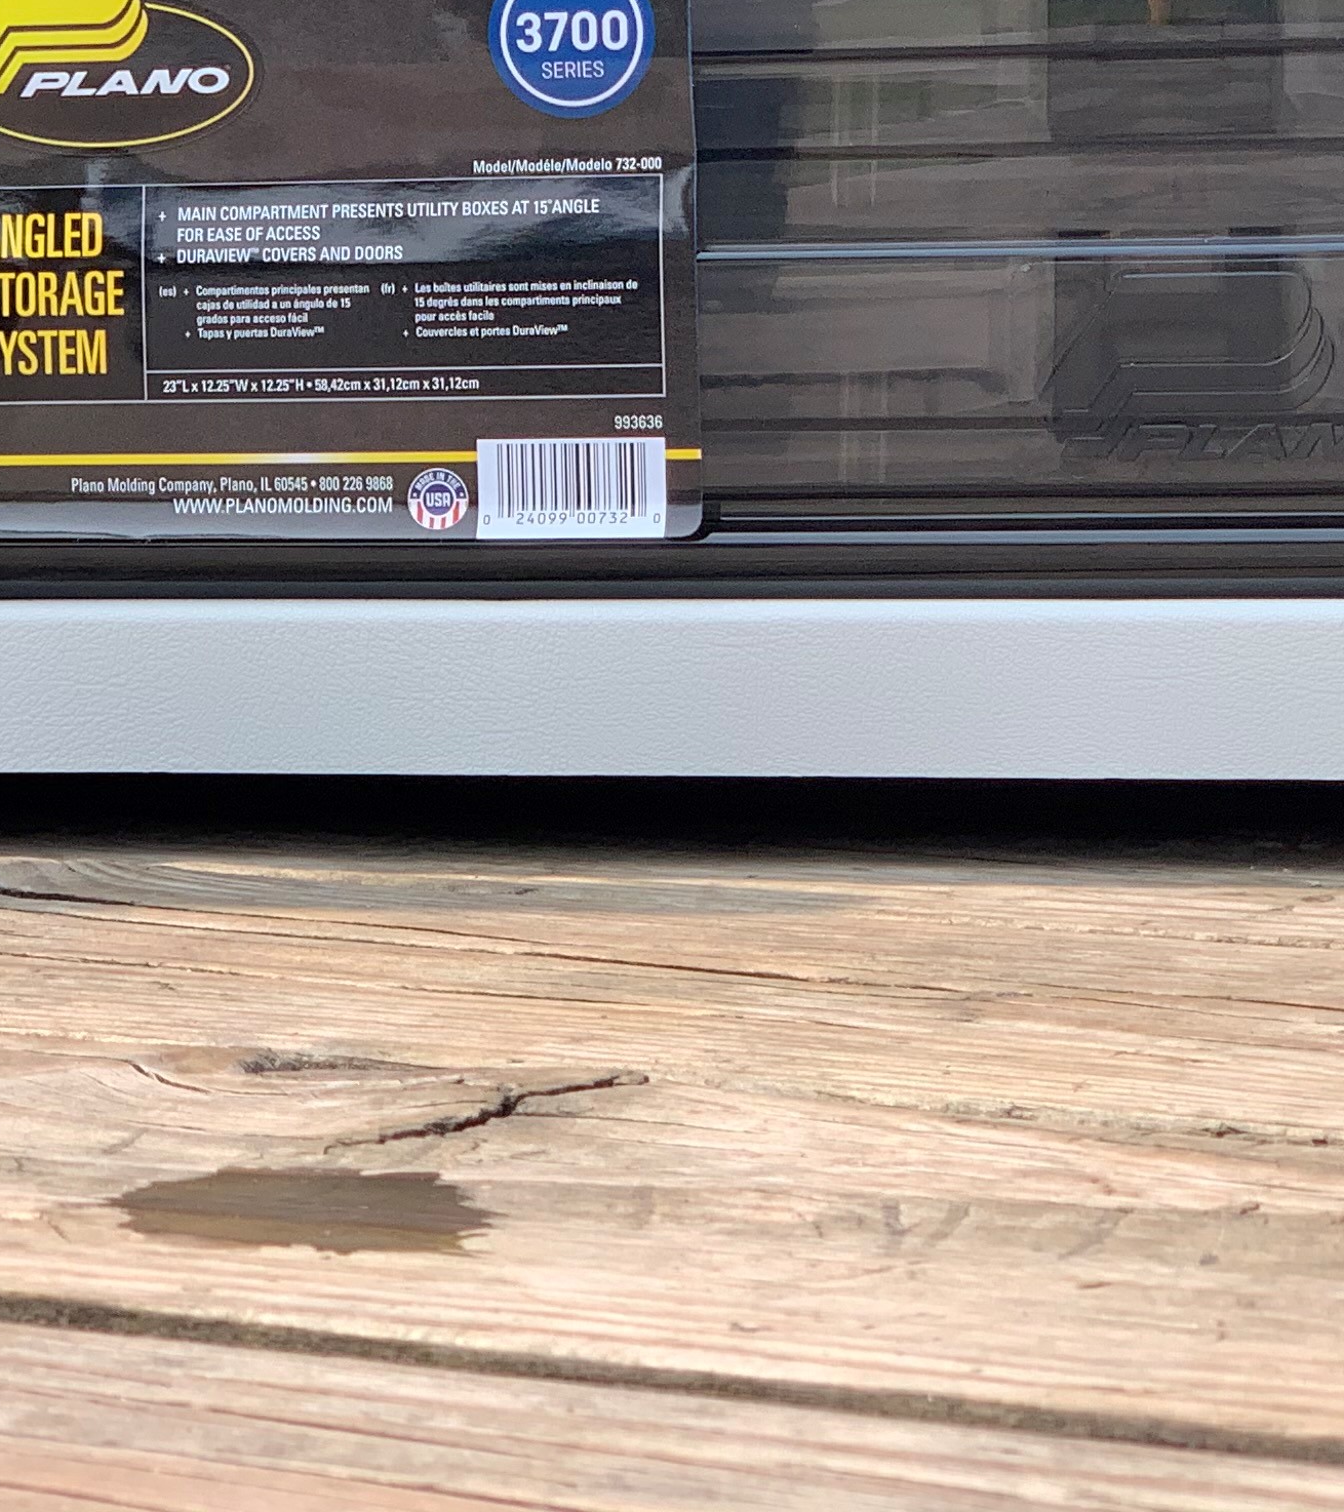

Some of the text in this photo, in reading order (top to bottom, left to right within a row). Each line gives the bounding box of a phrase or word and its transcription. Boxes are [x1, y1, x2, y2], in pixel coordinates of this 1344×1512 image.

[516, 9, 629, 53] 3700
[541, 60, 605, 80] SERIES
[20, 66, 230, 98] PLANO
[615, 156, 662, 171] 732-000
[177, 207, 217, 221] MAIN
[220, 204, 329, 221] COMPARTMENT
[331, 202, 404, 219] PRESENTS
[407, 202, 458, 217] UTILITY
[462, 200, 508, 216] BOXES
[512, 199, 530, 214] AT
[177, 225, 321, 242] FOR EASE OF ACCESS
[262, 247, 317, 263] COVERS
[319, 245, 351, 261] AND
[354, 245, 404, 261] DOORS
[271, 284, 321, 296] principales
[323, 284, 370, 296] presentan
[414, 283, 432, 293] Les
[463, 282, 506, 293] utilitaires
[508, 281, 528, 292] sont
[530, 280, 558, 291] mises
[560, 281, 571, 290] en
[626, 279, 638, 289] de
[222, 299, 234, 310] de
[236, 299, 270, 310] utilidad
[271, 301, 278, 309] a
[279, 300, 291, 309] un
[326, 298, 338, 308] de
[341, 298, 351, 308] 15
[415, 297, 425, 307] 15
[461, 296, 483, 306] dans
[485, 295, 499, 306] les
[196, 314, 228, 326] grados
[230, 314, 251, 325] para
[252, 314, 286, 323] acceso
[414, 313, 436, 323] pour
[197, 327, 225, 339] Tapas
[226, 329, 232, 339] y
[233, 327, 268, 339] puertas
[416, 326, 468, 338] Couvercles
[469, 326, 480, 337] et
[481, 326, 510, 338] portes
[191, 383, 199, 392] x
[250, 382, 258, 392] x
[363, 381, 371, 391] x
[373, 378, 420, 392] 31,12cm
[422, 381, 430, 390] x
[432, 378, 480, 391] 31,12cm
[614, 414, 663, 429] 993636
[71, 475, 393, 494] Plano Molding Company, Plano, IL 60545 800 226 9868
[173, 496, 393, 514] WWW.PLANOMOLDING.COM
[426, 492, 451, 507] USA
[483, 511, 661, 525] 0 24099 00732 0
